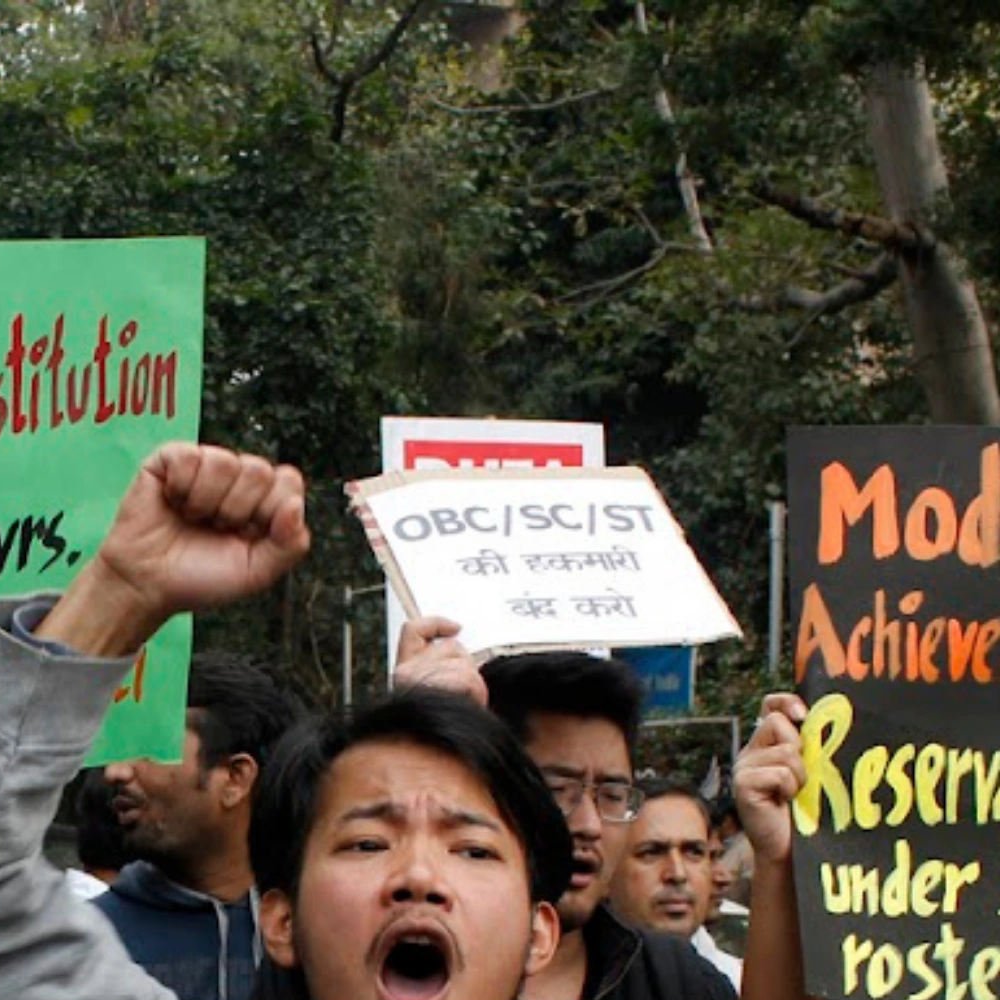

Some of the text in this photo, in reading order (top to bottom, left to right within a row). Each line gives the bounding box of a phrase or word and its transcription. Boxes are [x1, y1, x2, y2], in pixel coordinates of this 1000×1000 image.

[393, 503, 656, 542] OBC/SC/ST
[792, 693, 1000, 837] Reserv
[820, 839, 981, 918] under
